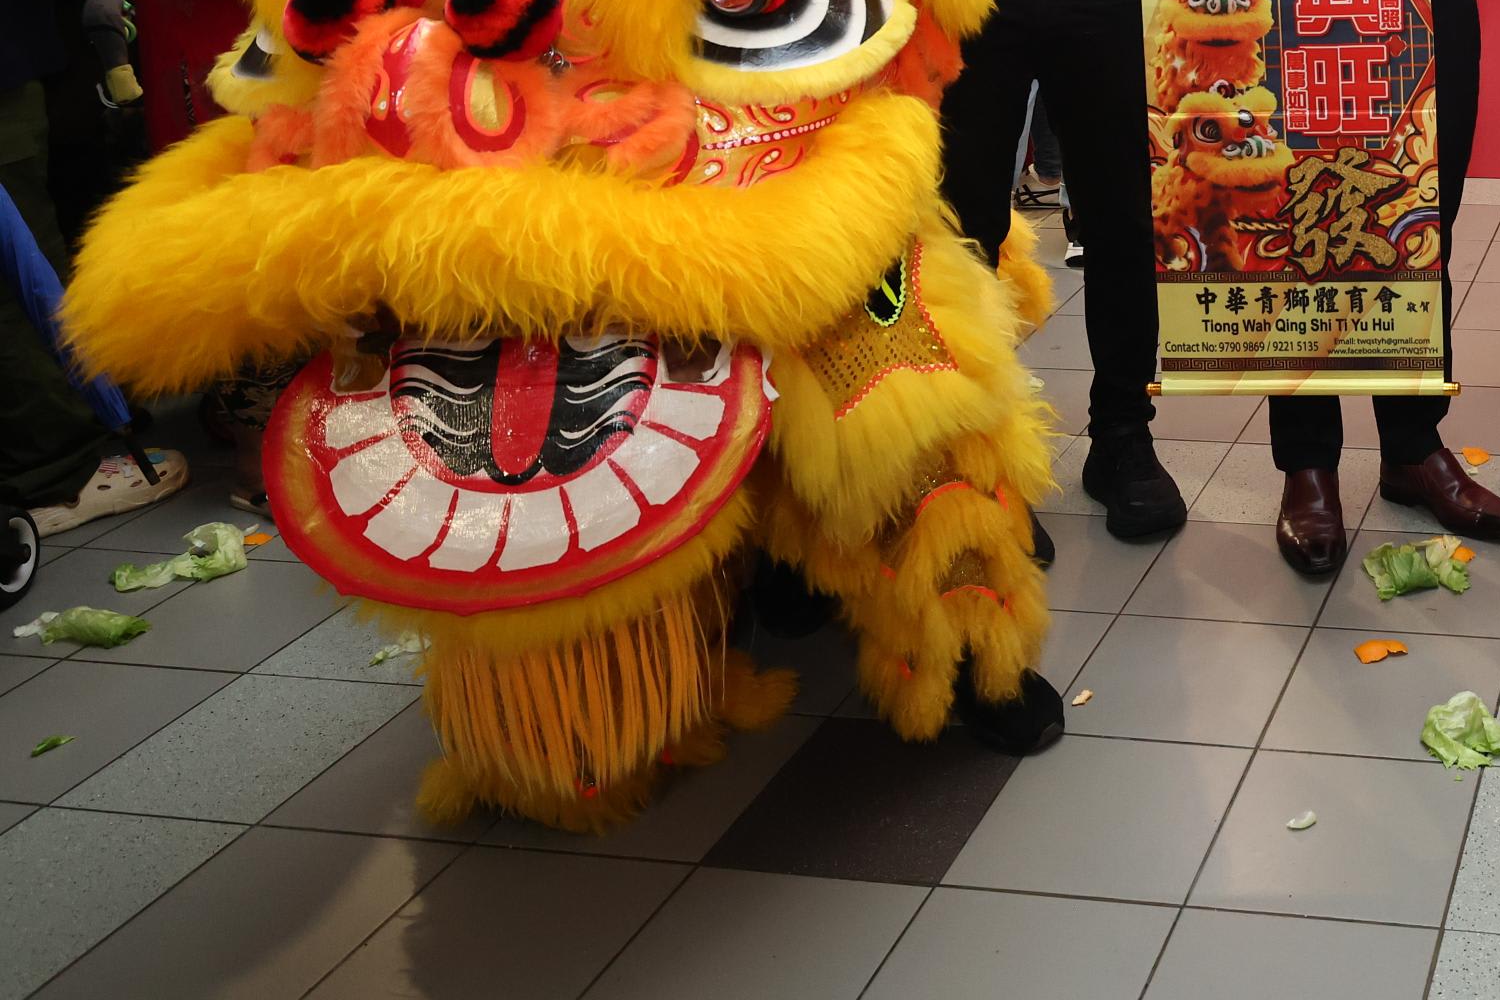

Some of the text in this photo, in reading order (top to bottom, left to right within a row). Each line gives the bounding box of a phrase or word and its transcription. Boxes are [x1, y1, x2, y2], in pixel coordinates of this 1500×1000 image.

[1202, 318, 1395, 335] Tiong Wah Qing Shi Ti Yu Hui
[1165, 341, 1199, 353] Contact
[1202, 341, 1217, 353] No:
[1218, 341, 1241, 352] 9790
[1242, 341, 1265, 352] 9869
[1273, 341, 1295, 352] 9221
[1297, 341, 1319, 352] 5135
[1334, 337, 1355, 346] Email:
